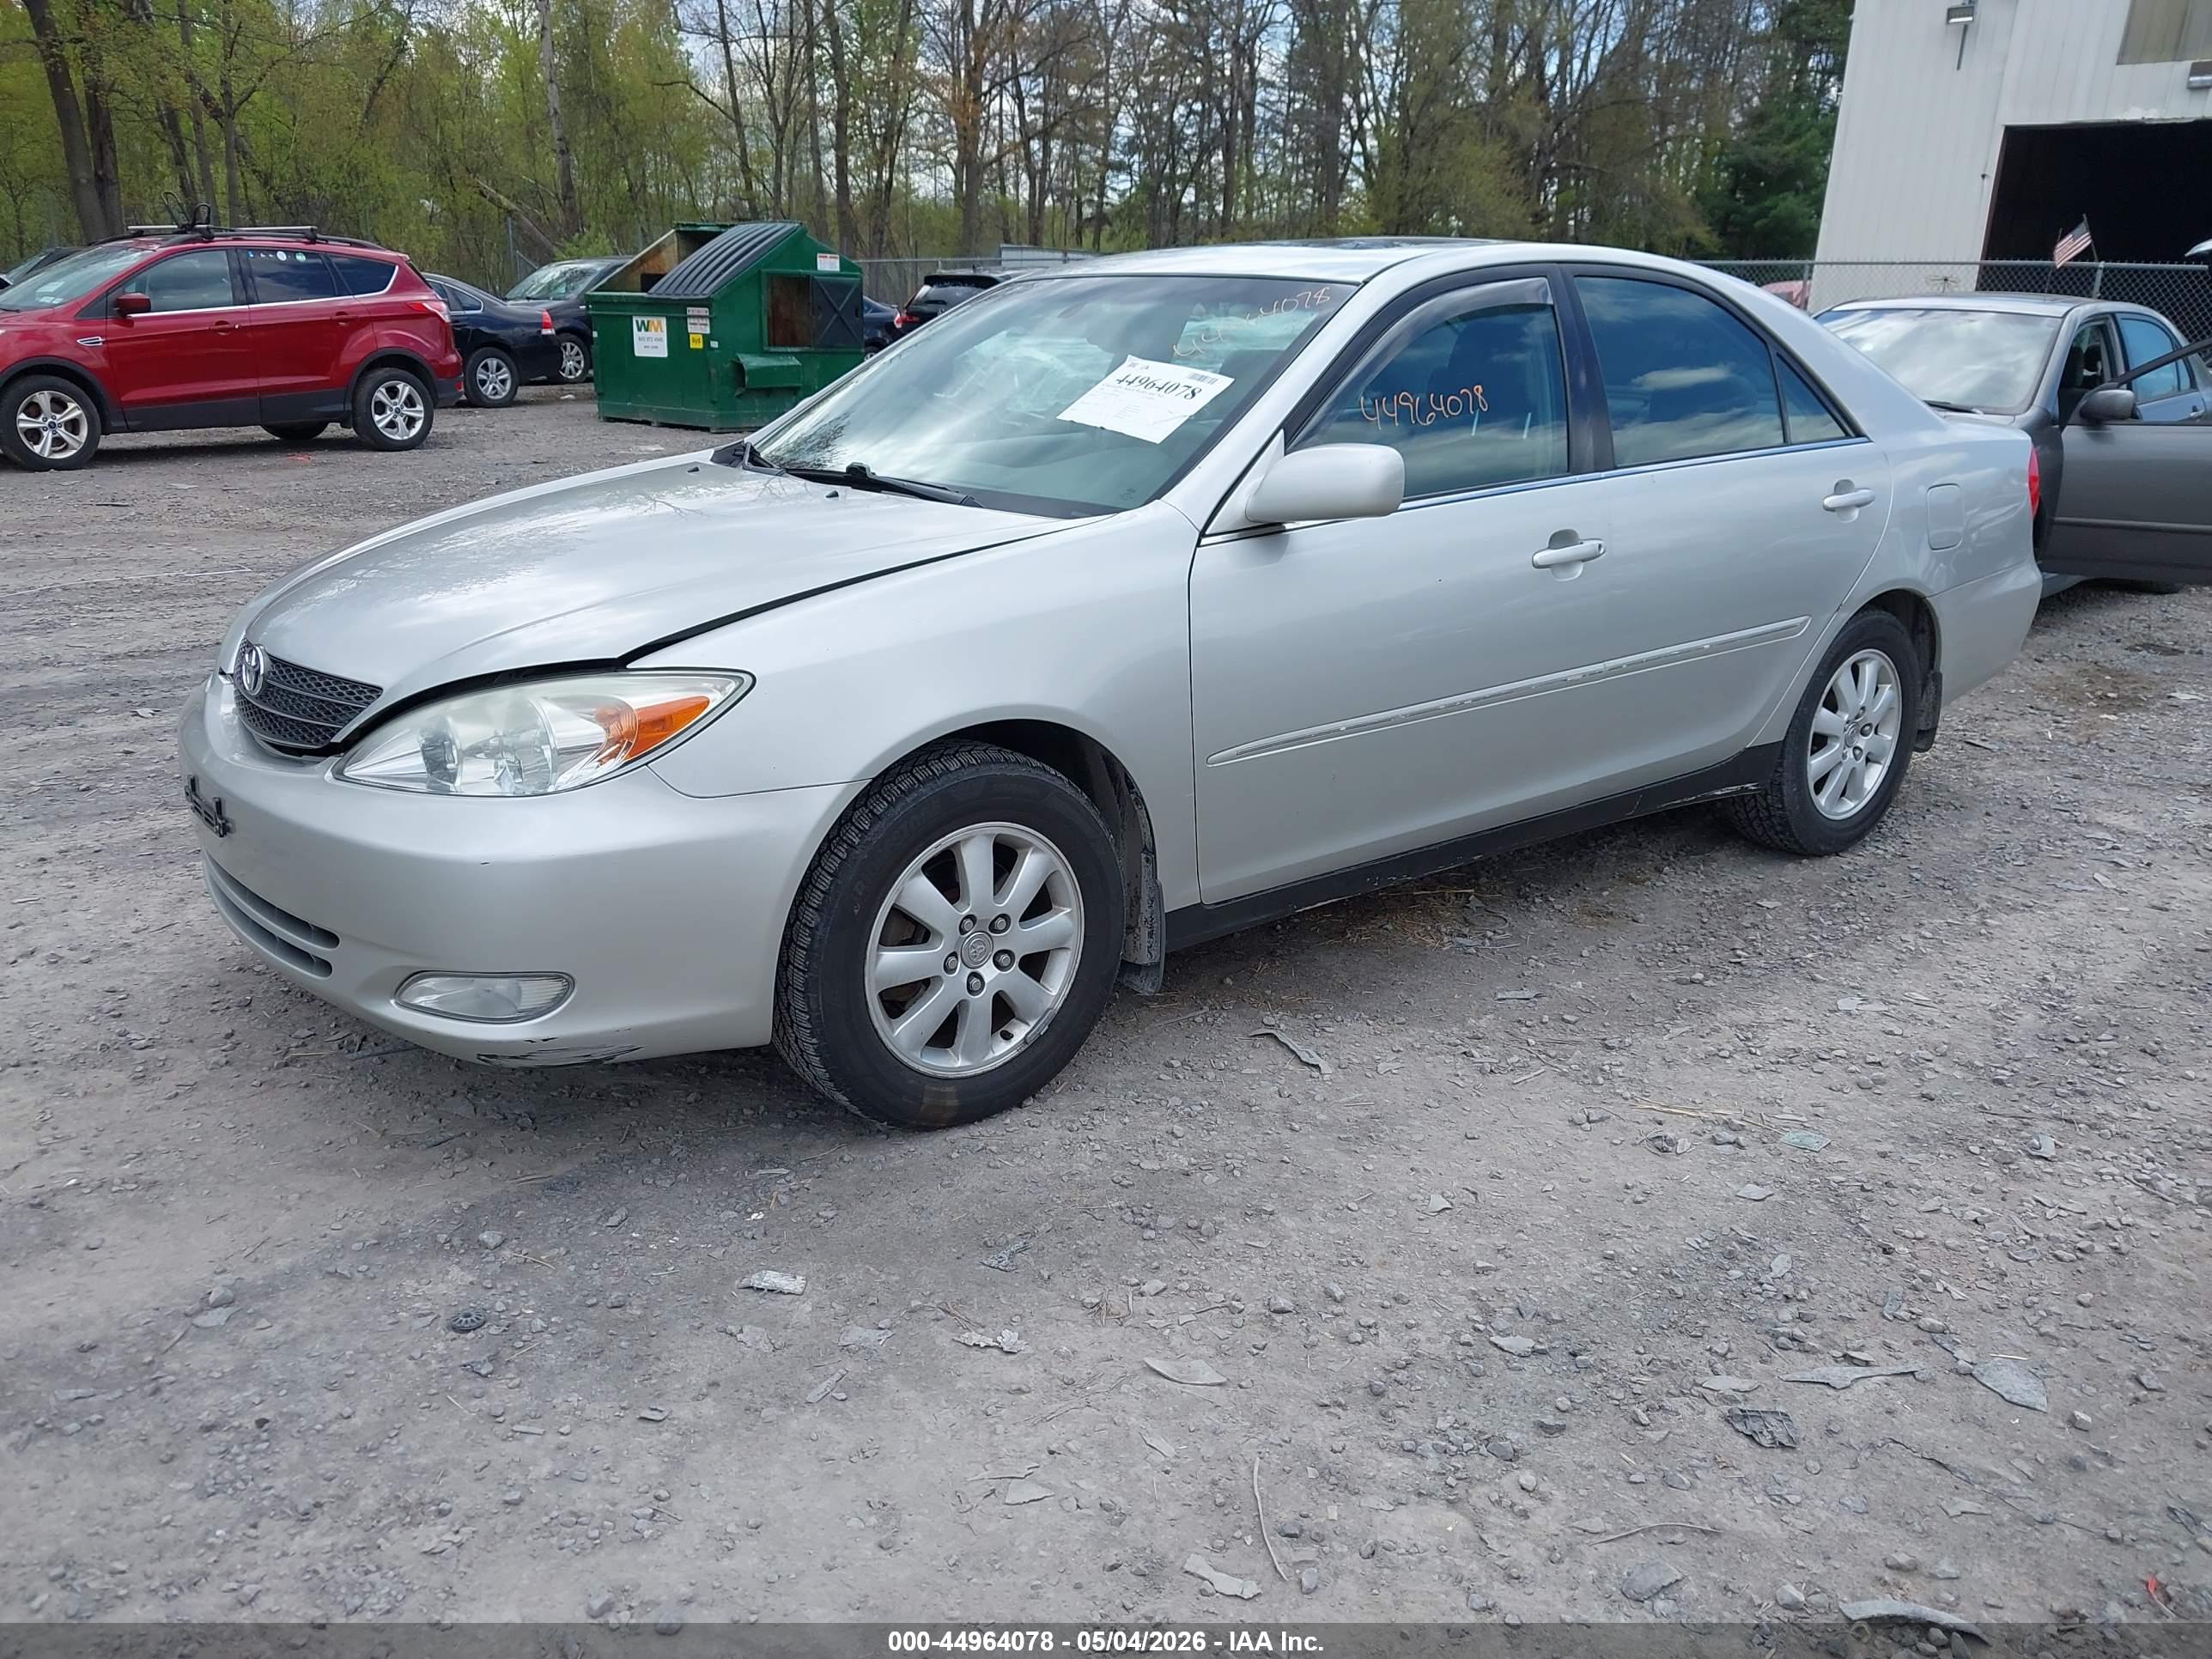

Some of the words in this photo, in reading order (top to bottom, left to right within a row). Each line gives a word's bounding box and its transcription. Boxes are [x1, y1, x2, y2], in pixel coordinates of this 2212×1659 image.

[635, 319, 664, 332] WM
[1116, 374, 1202, 400] 44964078
[1360, 385, 1488, 430] 44964078
